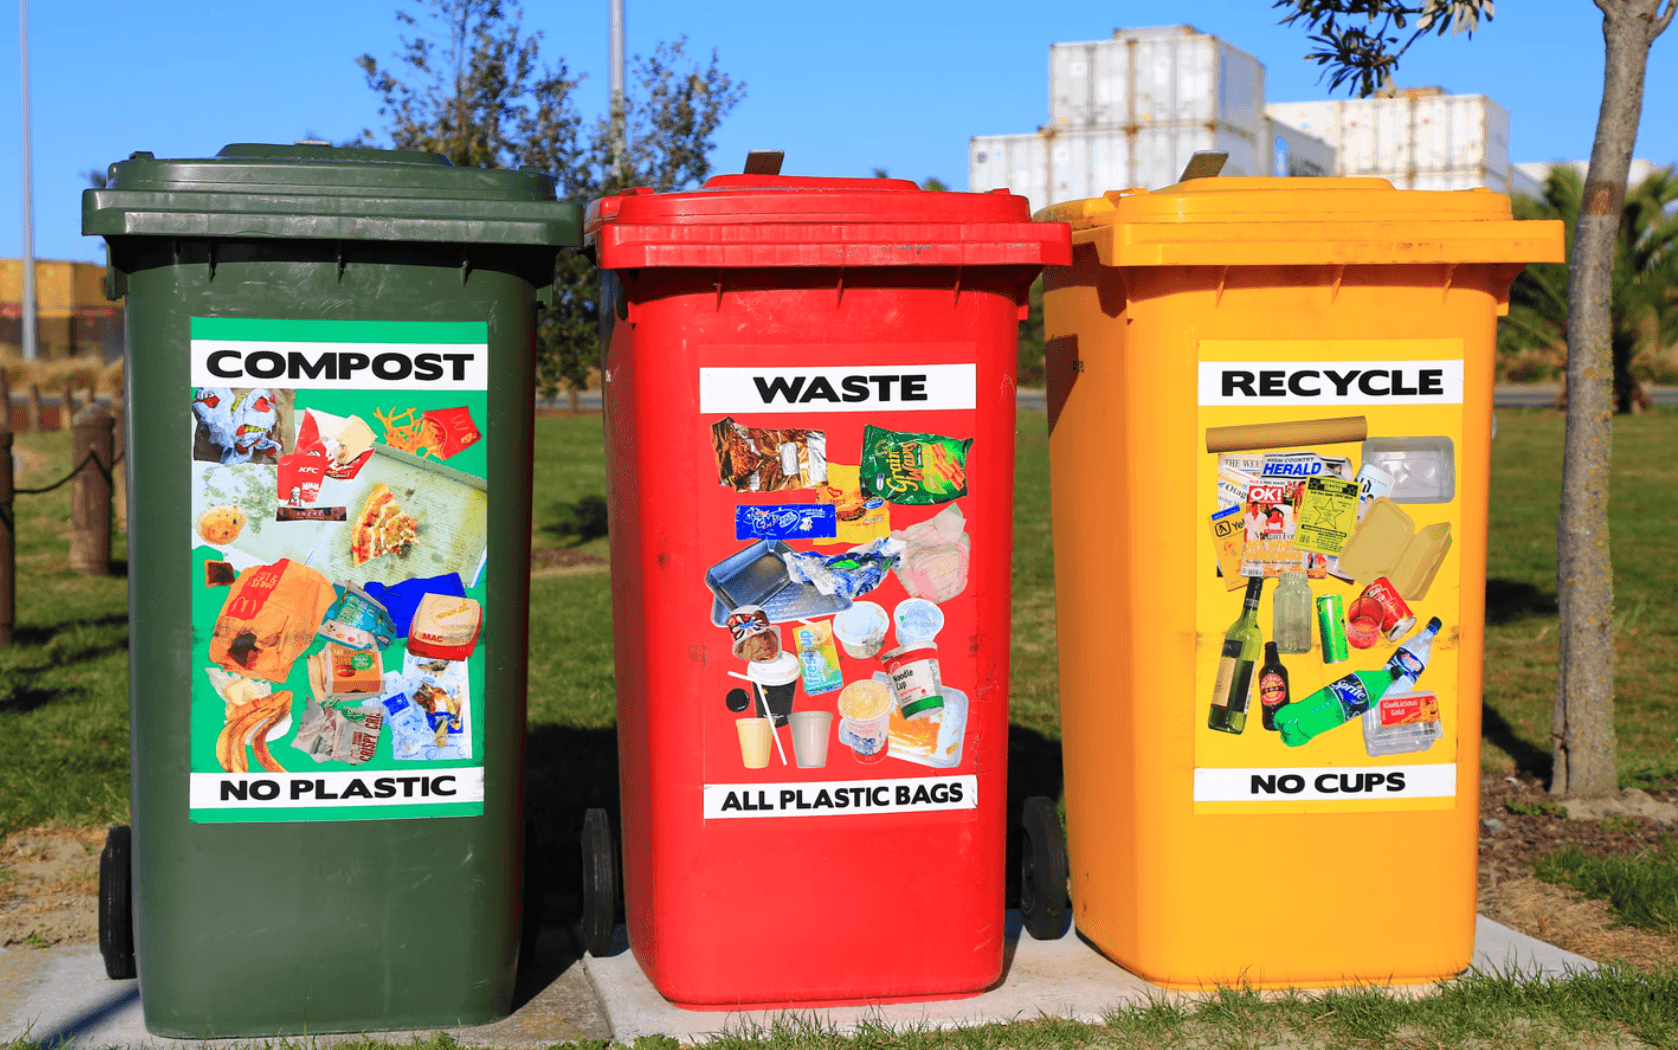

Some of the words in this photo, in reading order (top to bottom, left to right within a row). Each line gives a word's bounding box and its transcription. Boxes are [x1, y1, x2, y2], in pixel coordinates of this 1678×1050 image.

[206, 349, 475, 381] COMPOST
[753, 374, 928, 403] WASTE
[1221, 369, 1444, 397] RECYCLE
[886, 451, 919, 493] Grain
[1263, 462, 1322, 475] HERALD
[1250, 487, 1282, 501] OK!
[421, 632, 443, 643] MAC
[893, 669, 914, 682] Noodle
[896, 681, 907, 691] Cup
[219, 780, 281, 801] NO
[290, 775, 457, 801] PLASTIC
[1250, 774, 1305, 794] NO
[1314, 772, 1406, 793] CUPS
[721, 791, 774, 812] ALL
[780, 786, 890, 810] PLASTIC
[895, 782, 963, 806] BAGS
